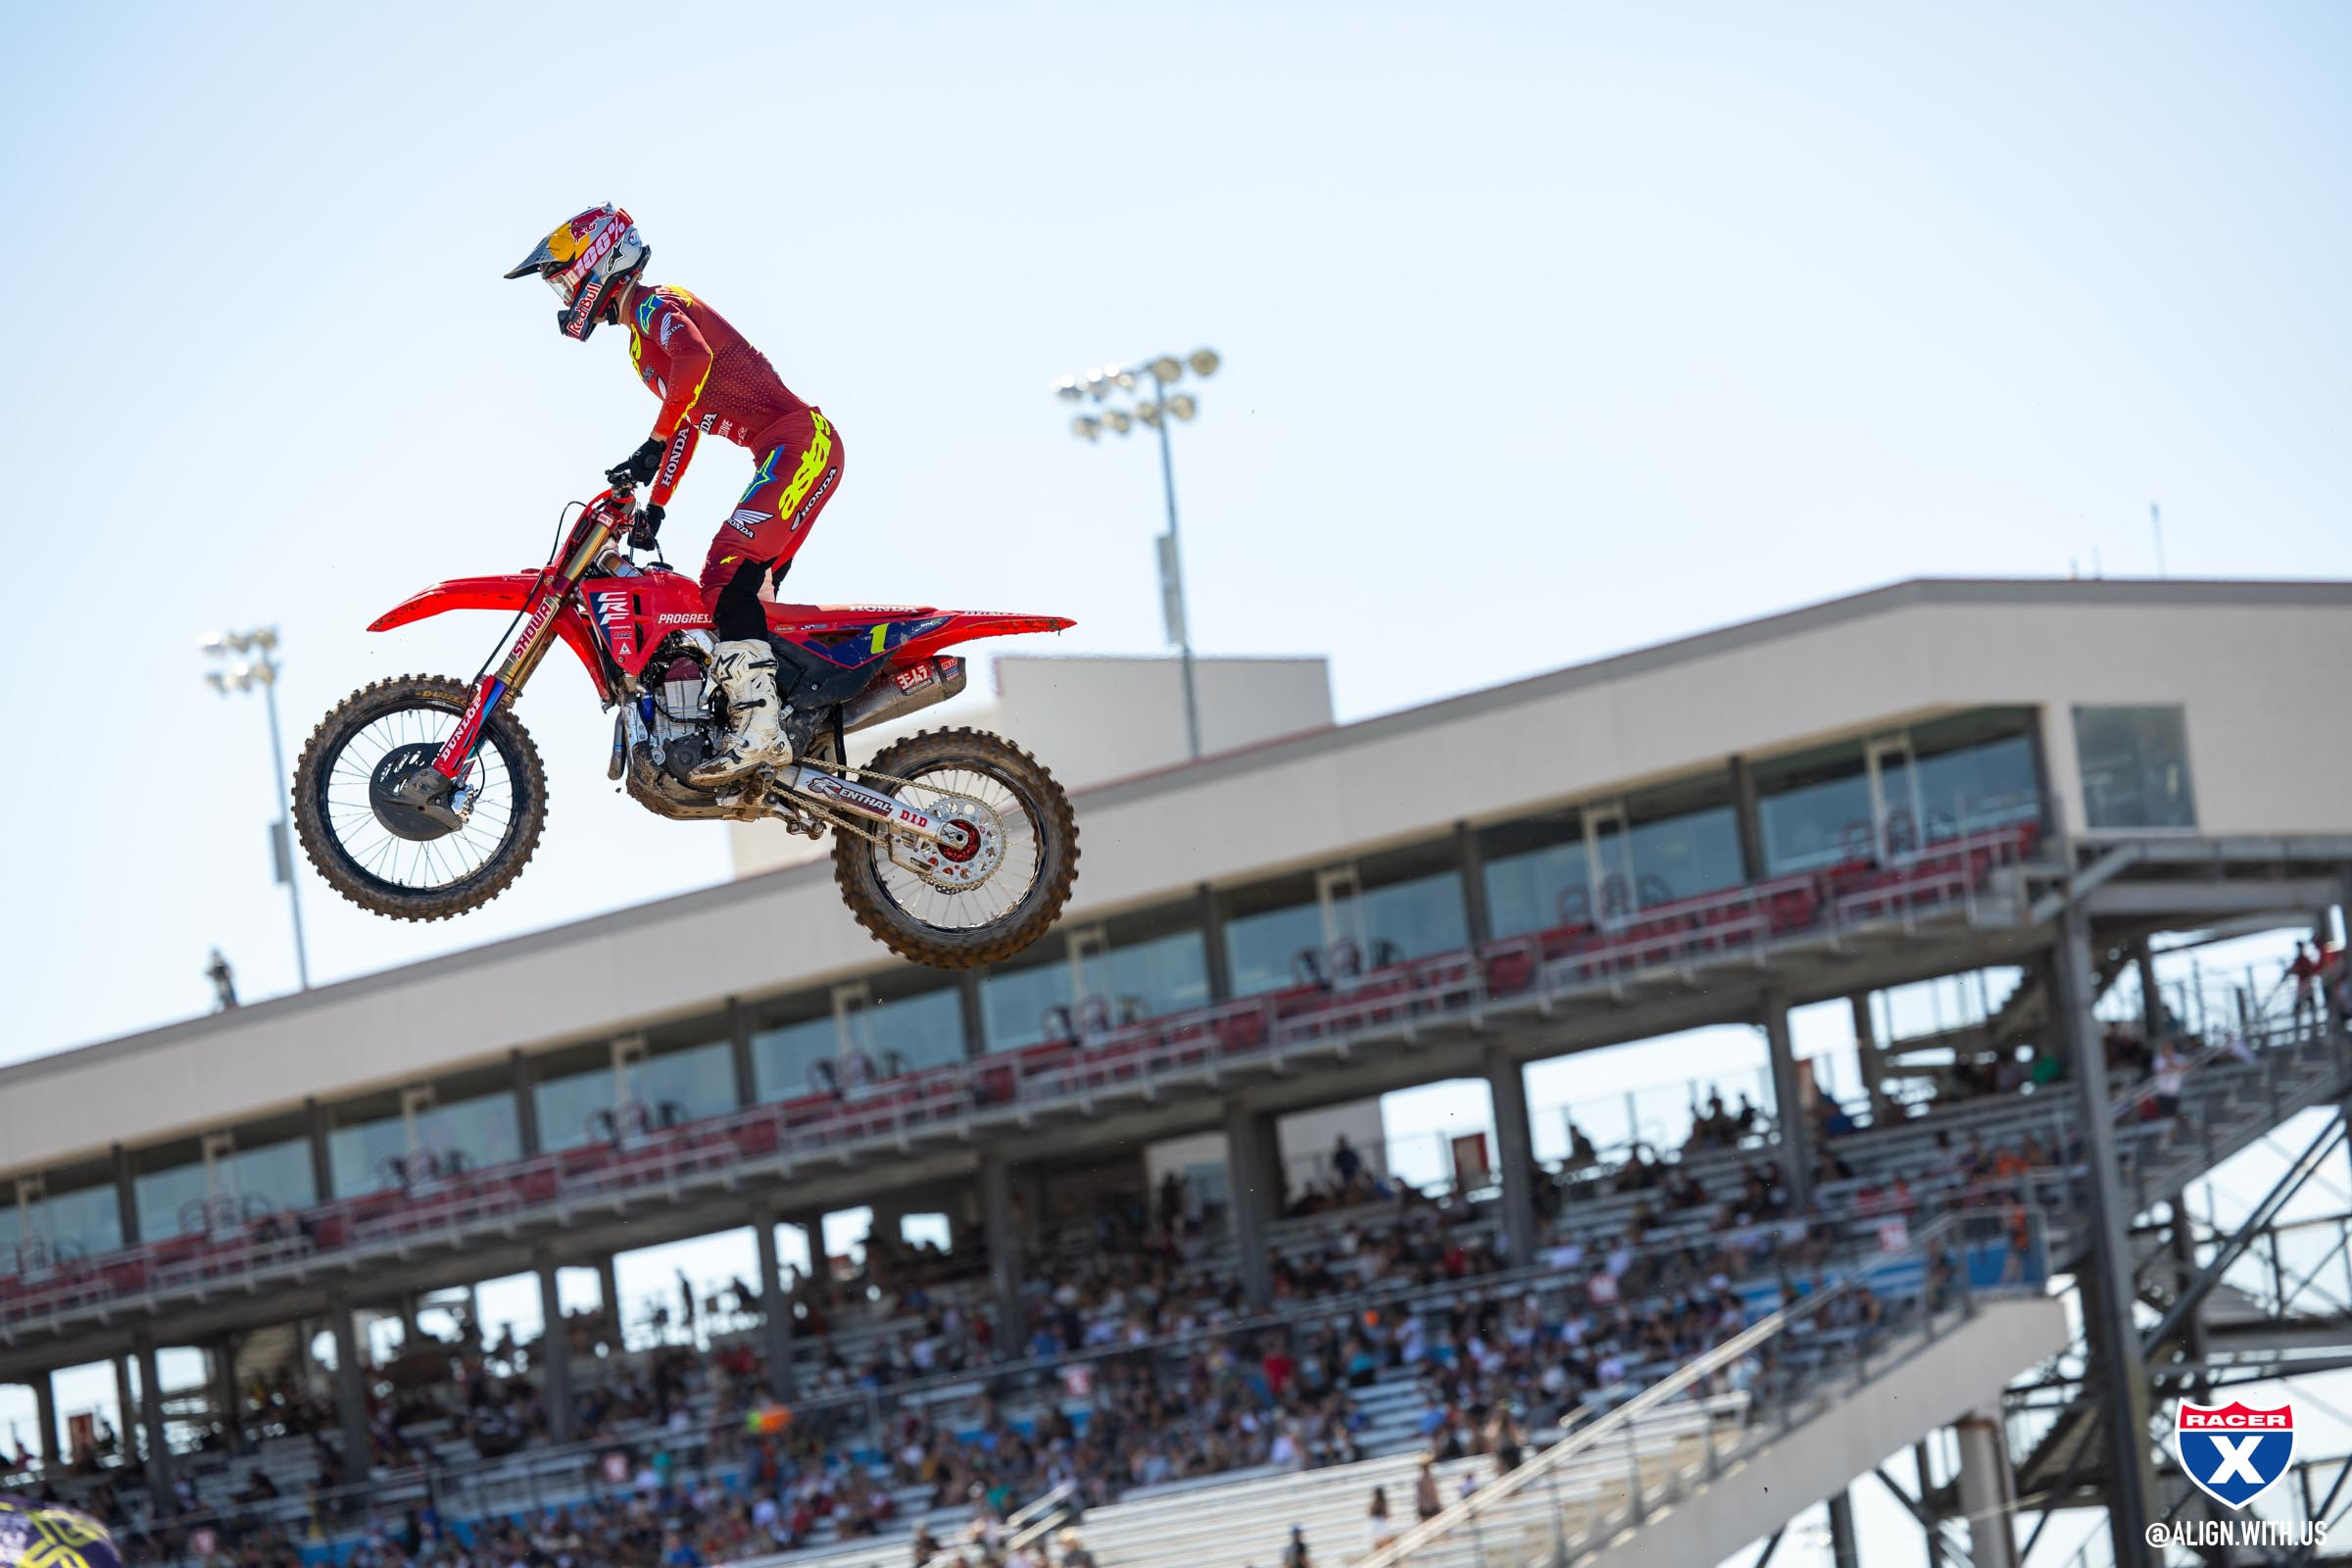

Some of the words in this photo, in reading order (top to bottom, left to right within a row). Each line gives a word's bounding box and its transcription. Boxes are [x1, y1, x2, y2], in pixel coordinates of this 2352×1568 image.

[573, 216, 625, 278] 100%
[661, 426, 690, 488] HONDA
[801, 467, 837, 518] HONDA
[512, 601, 552, 660] SHOWA
[658, 613, 713, 624] PROGRES
[849, 604, 919, 612] HONDA
[869, 622, 890, 655] 1
[441, 695, 482, 762] DUNLOP
[900, 808, 928, 829] D.I.D
